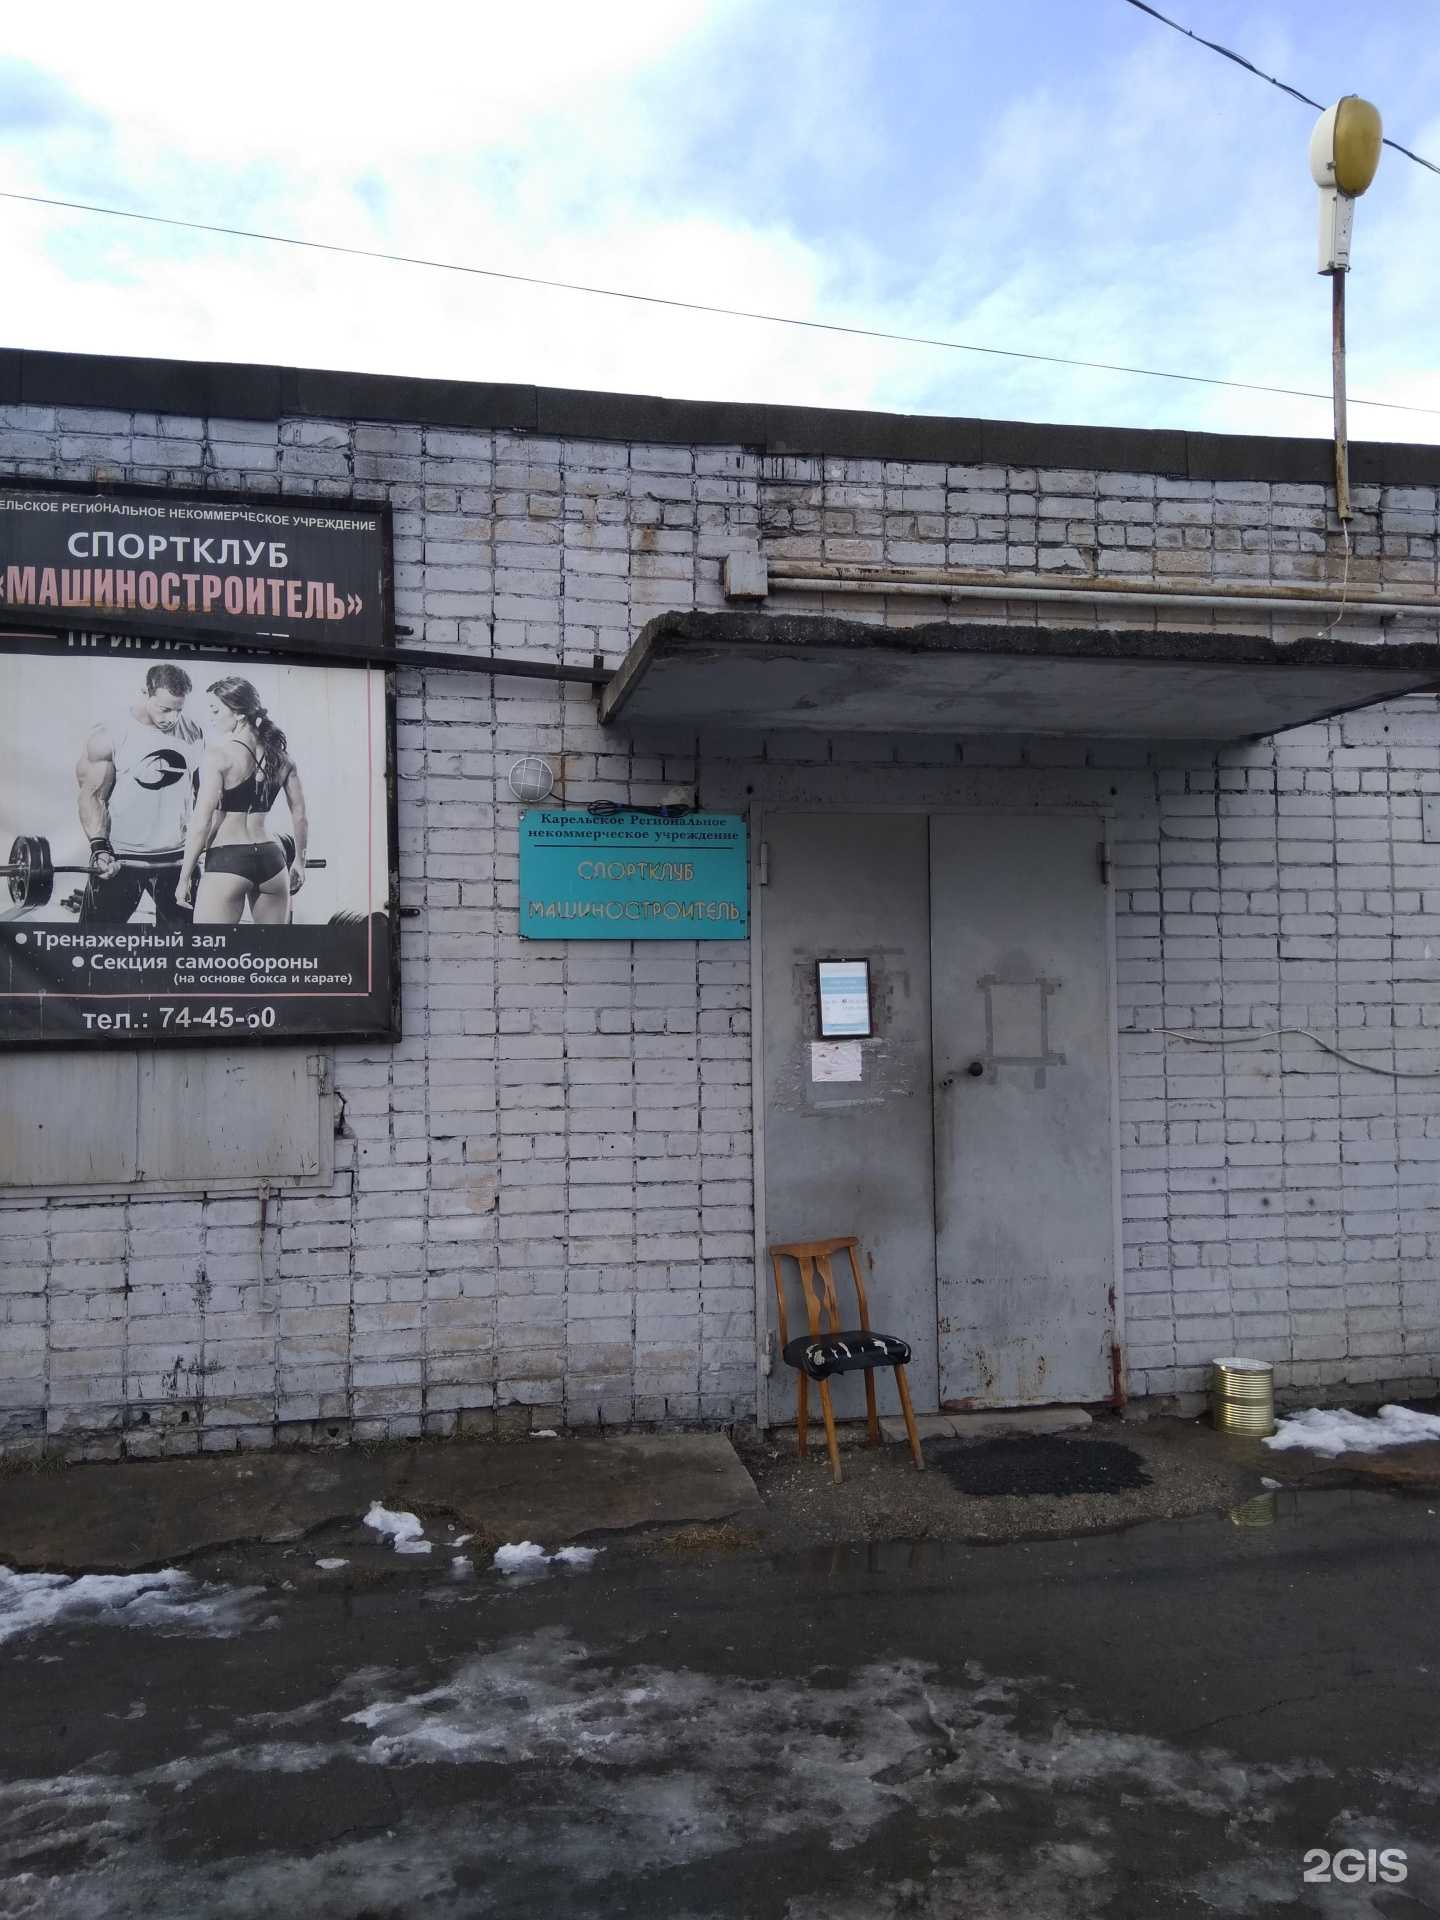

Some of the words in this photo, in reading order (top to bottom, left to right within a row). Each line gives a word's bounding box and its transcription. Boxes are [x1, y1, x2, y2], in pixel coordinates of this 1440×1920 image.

[62, 502, 166, 519] РЕГИОНАЛЬНОЕ
[168, 508, 290, 526] НЕКОММЕРЧЕСКОЕ
[292, 516, 377, 532] УЧРЕЖДЕНИЕ
[67, 531, 290, 569] СПОРТКЛУБ
[541, 813, 625, 827] Карельское
[630, 815, 728, 827] Региональное
[528, 828, 650, 842] некоммерческое
[655, 831, 740, 843] учреждение
[577, 861, 695, 882] СПОРТКЛУБ
[529, 902, 741, 921] МАШИНОСТРОИТЕЛЬ
[33, 930, 185, 951] Тренажерный
[191, 934, 228, 949] зал
[90, 954, 168, 973] Секция
[175, 952, 319, 972] самообороны
[173, 973, 196, 986] (на
[200, 975, 246, 985] основе
[249, 973, 288, 985] бокса
[291, 975, 301, 985] и
[304, 974, 354, 987] карате)
[82, 1011, 149, 1030] тел.:
